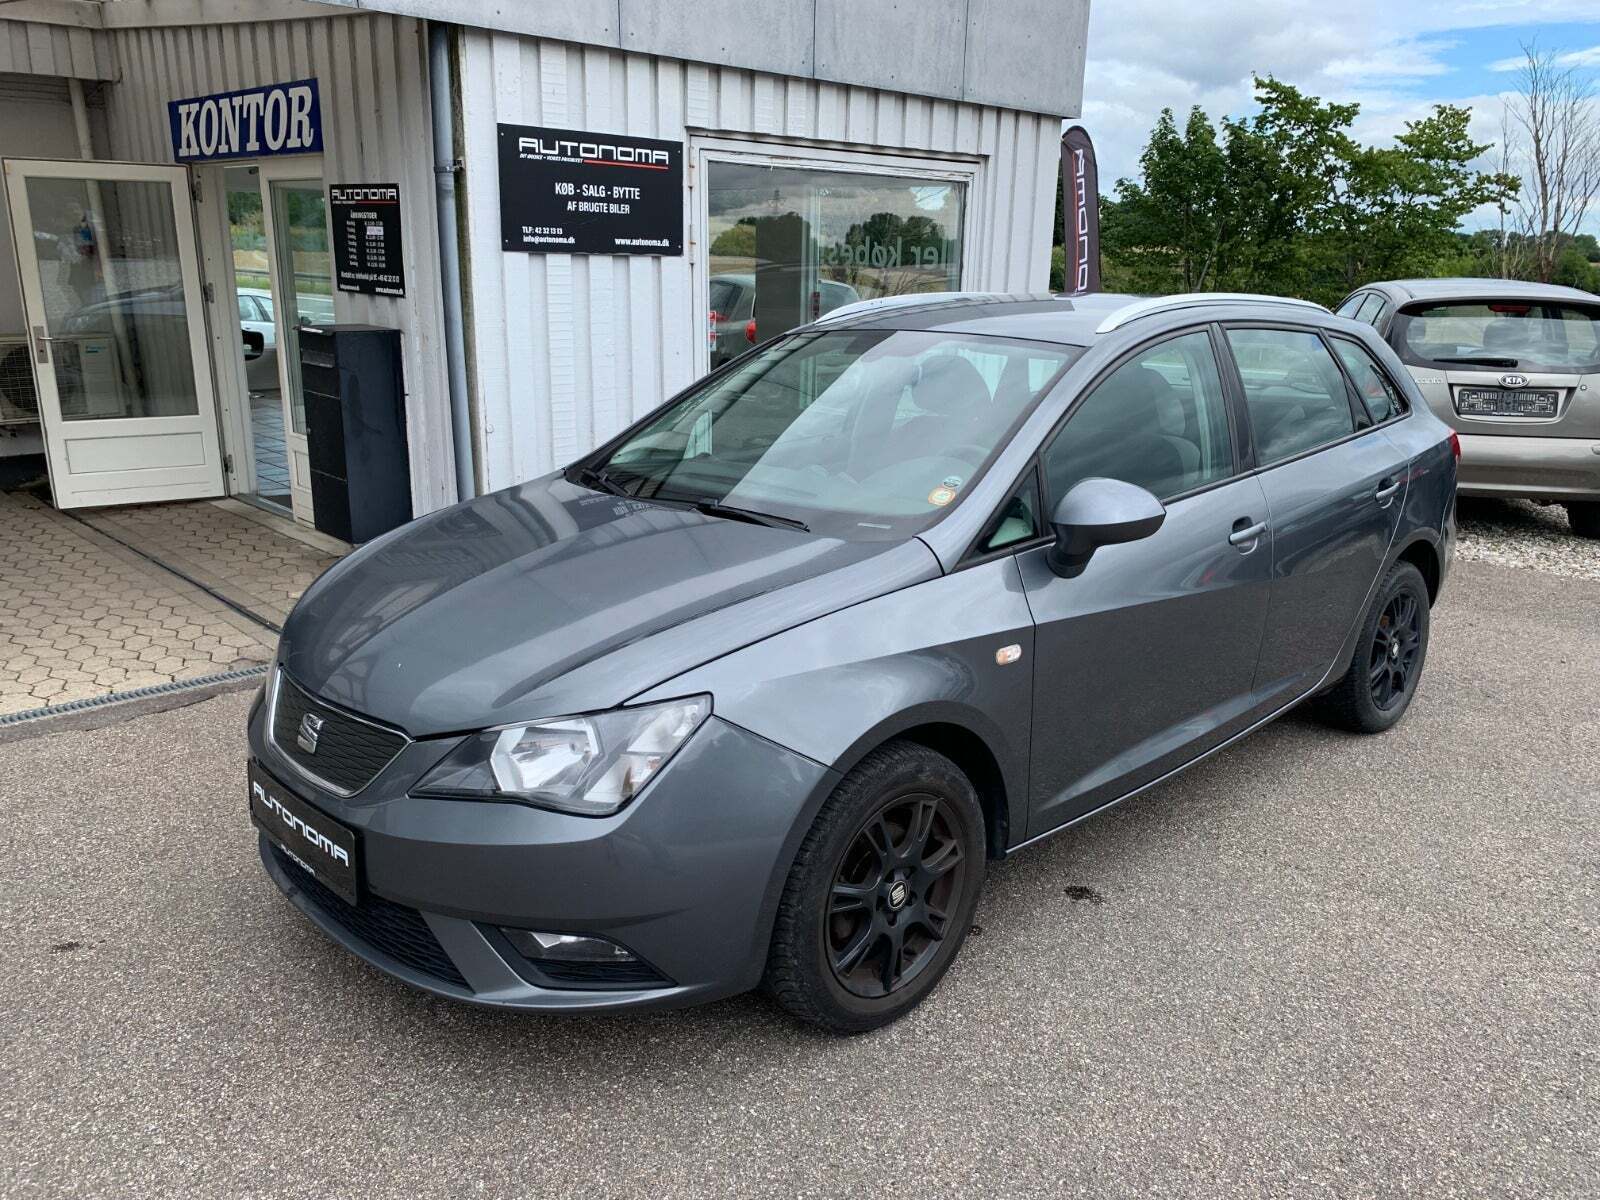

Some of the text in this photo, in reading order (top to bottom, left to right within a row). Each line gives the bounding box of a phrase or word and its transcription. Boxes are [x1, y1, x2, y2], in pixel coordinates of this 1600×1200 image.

[178, 86, 314, 157] KONTOR
[518, 136, 669, 165] AUTONOMA
[332, 188, 397, 201] AUTONOMA
[554, 182, 575, 195] KØB
[582, 184, 606, 198] SALG
[613, 186, 641, 200] BYTTE
[567, 201, 630, 214] AF BRUGTE BILER
[523, 234, 576, 245] info@autonoma.dk
[614, 237, 670, 247] www.autonoma.dk
[1505, 377, 1524, 385] KIA
[252, 781, 350, 868] AUTONOMA
